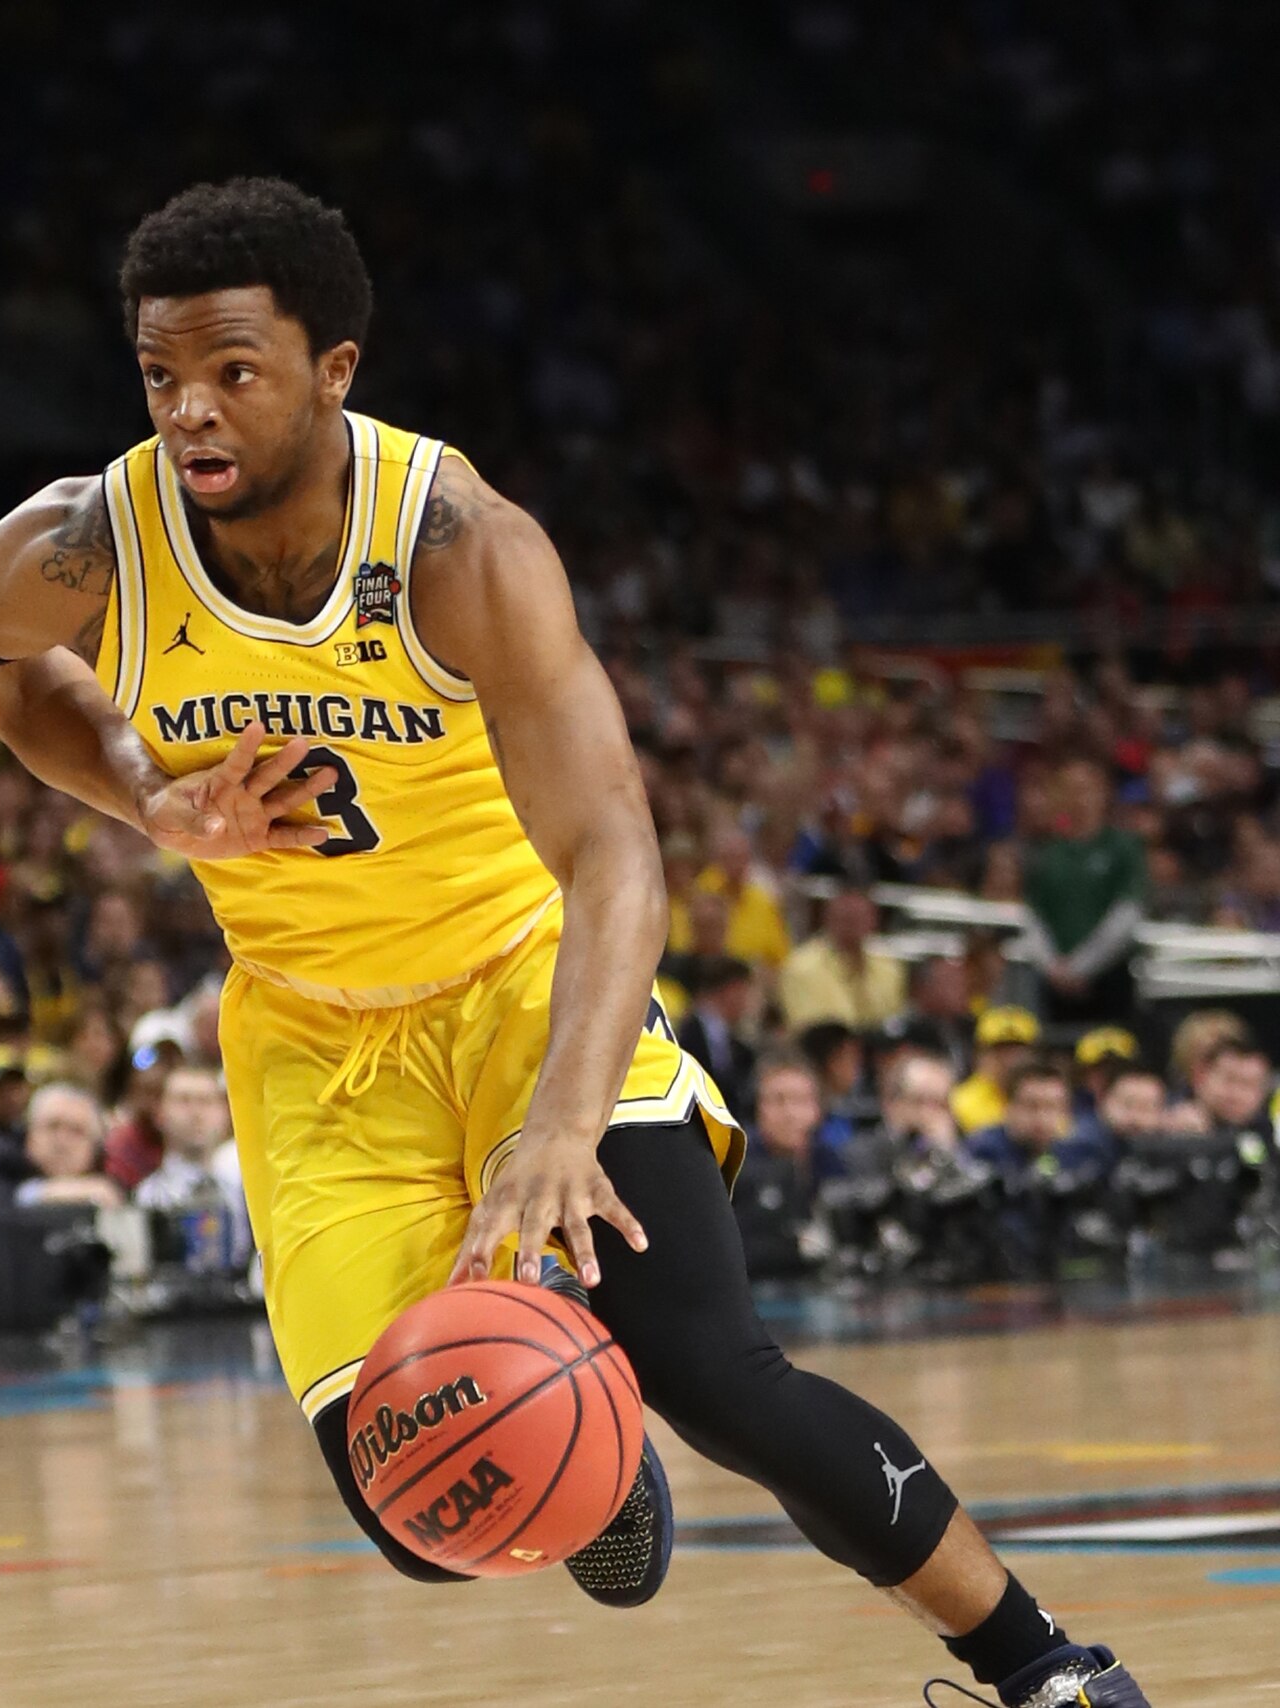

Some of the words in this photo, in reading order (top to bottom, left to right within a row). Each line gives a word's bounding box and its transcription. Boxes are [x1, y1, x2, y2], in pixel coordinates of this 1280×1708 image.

[355, 573, 389, 595] FINAL
[359, 588, 392, 608] FOUR
[150, 692, 447, 743] MICHIGAN
[285, 745, 381, 857] 3
[349, 1375, 487, 1491] Wilson
[402, 1457, 514, 1548] NCAA
